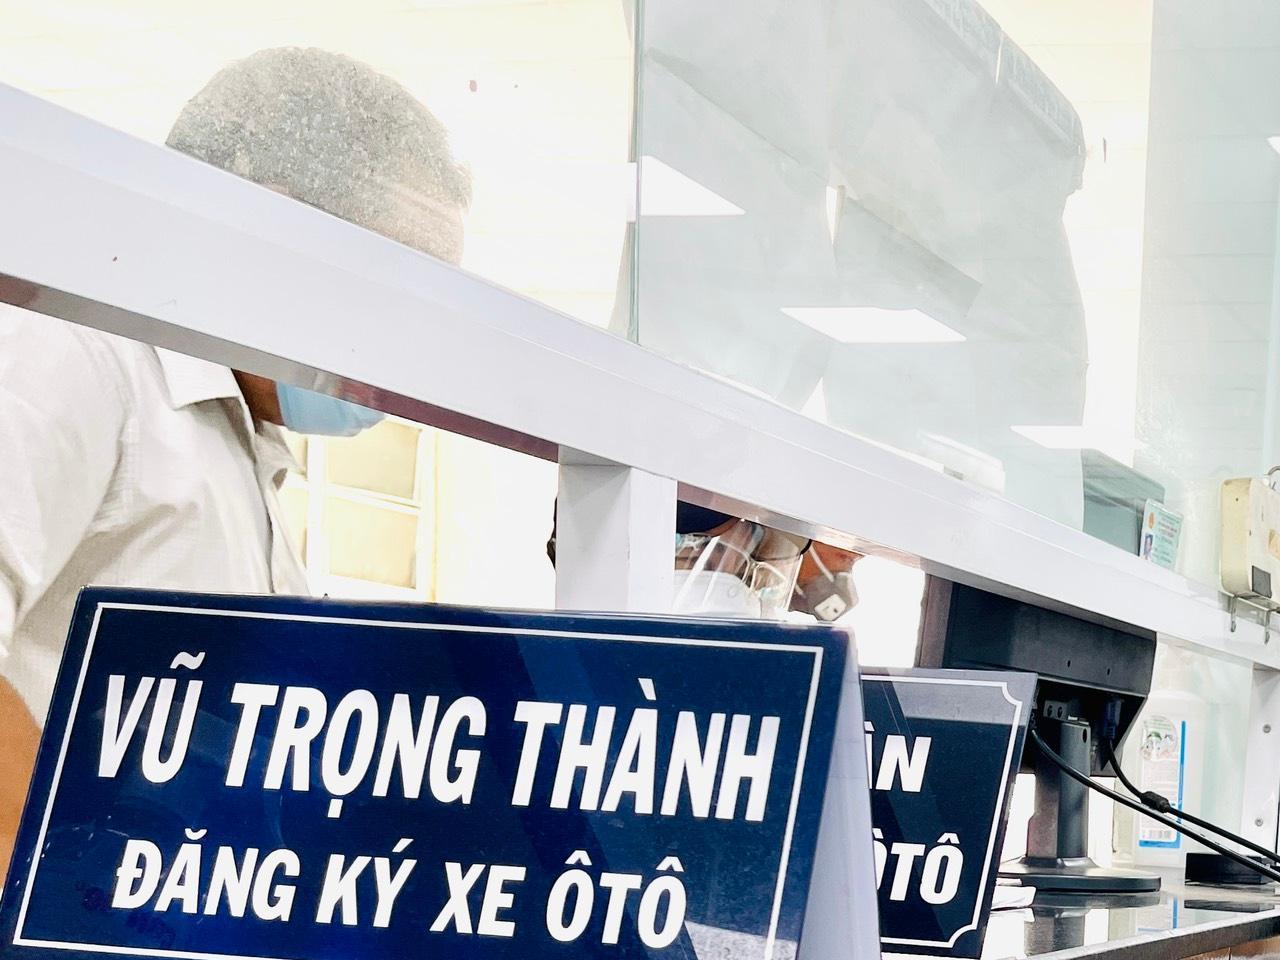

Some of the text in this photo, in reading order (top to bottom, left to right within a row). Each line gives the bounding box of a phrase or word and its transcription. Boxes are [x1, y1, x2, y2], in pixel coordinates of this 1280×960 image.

[96, 652, 782, 822] VŨ TRỌNG THÀNH
[112, 828, 688, 949] ĐĂNG KÝ XE ÔTÔ
